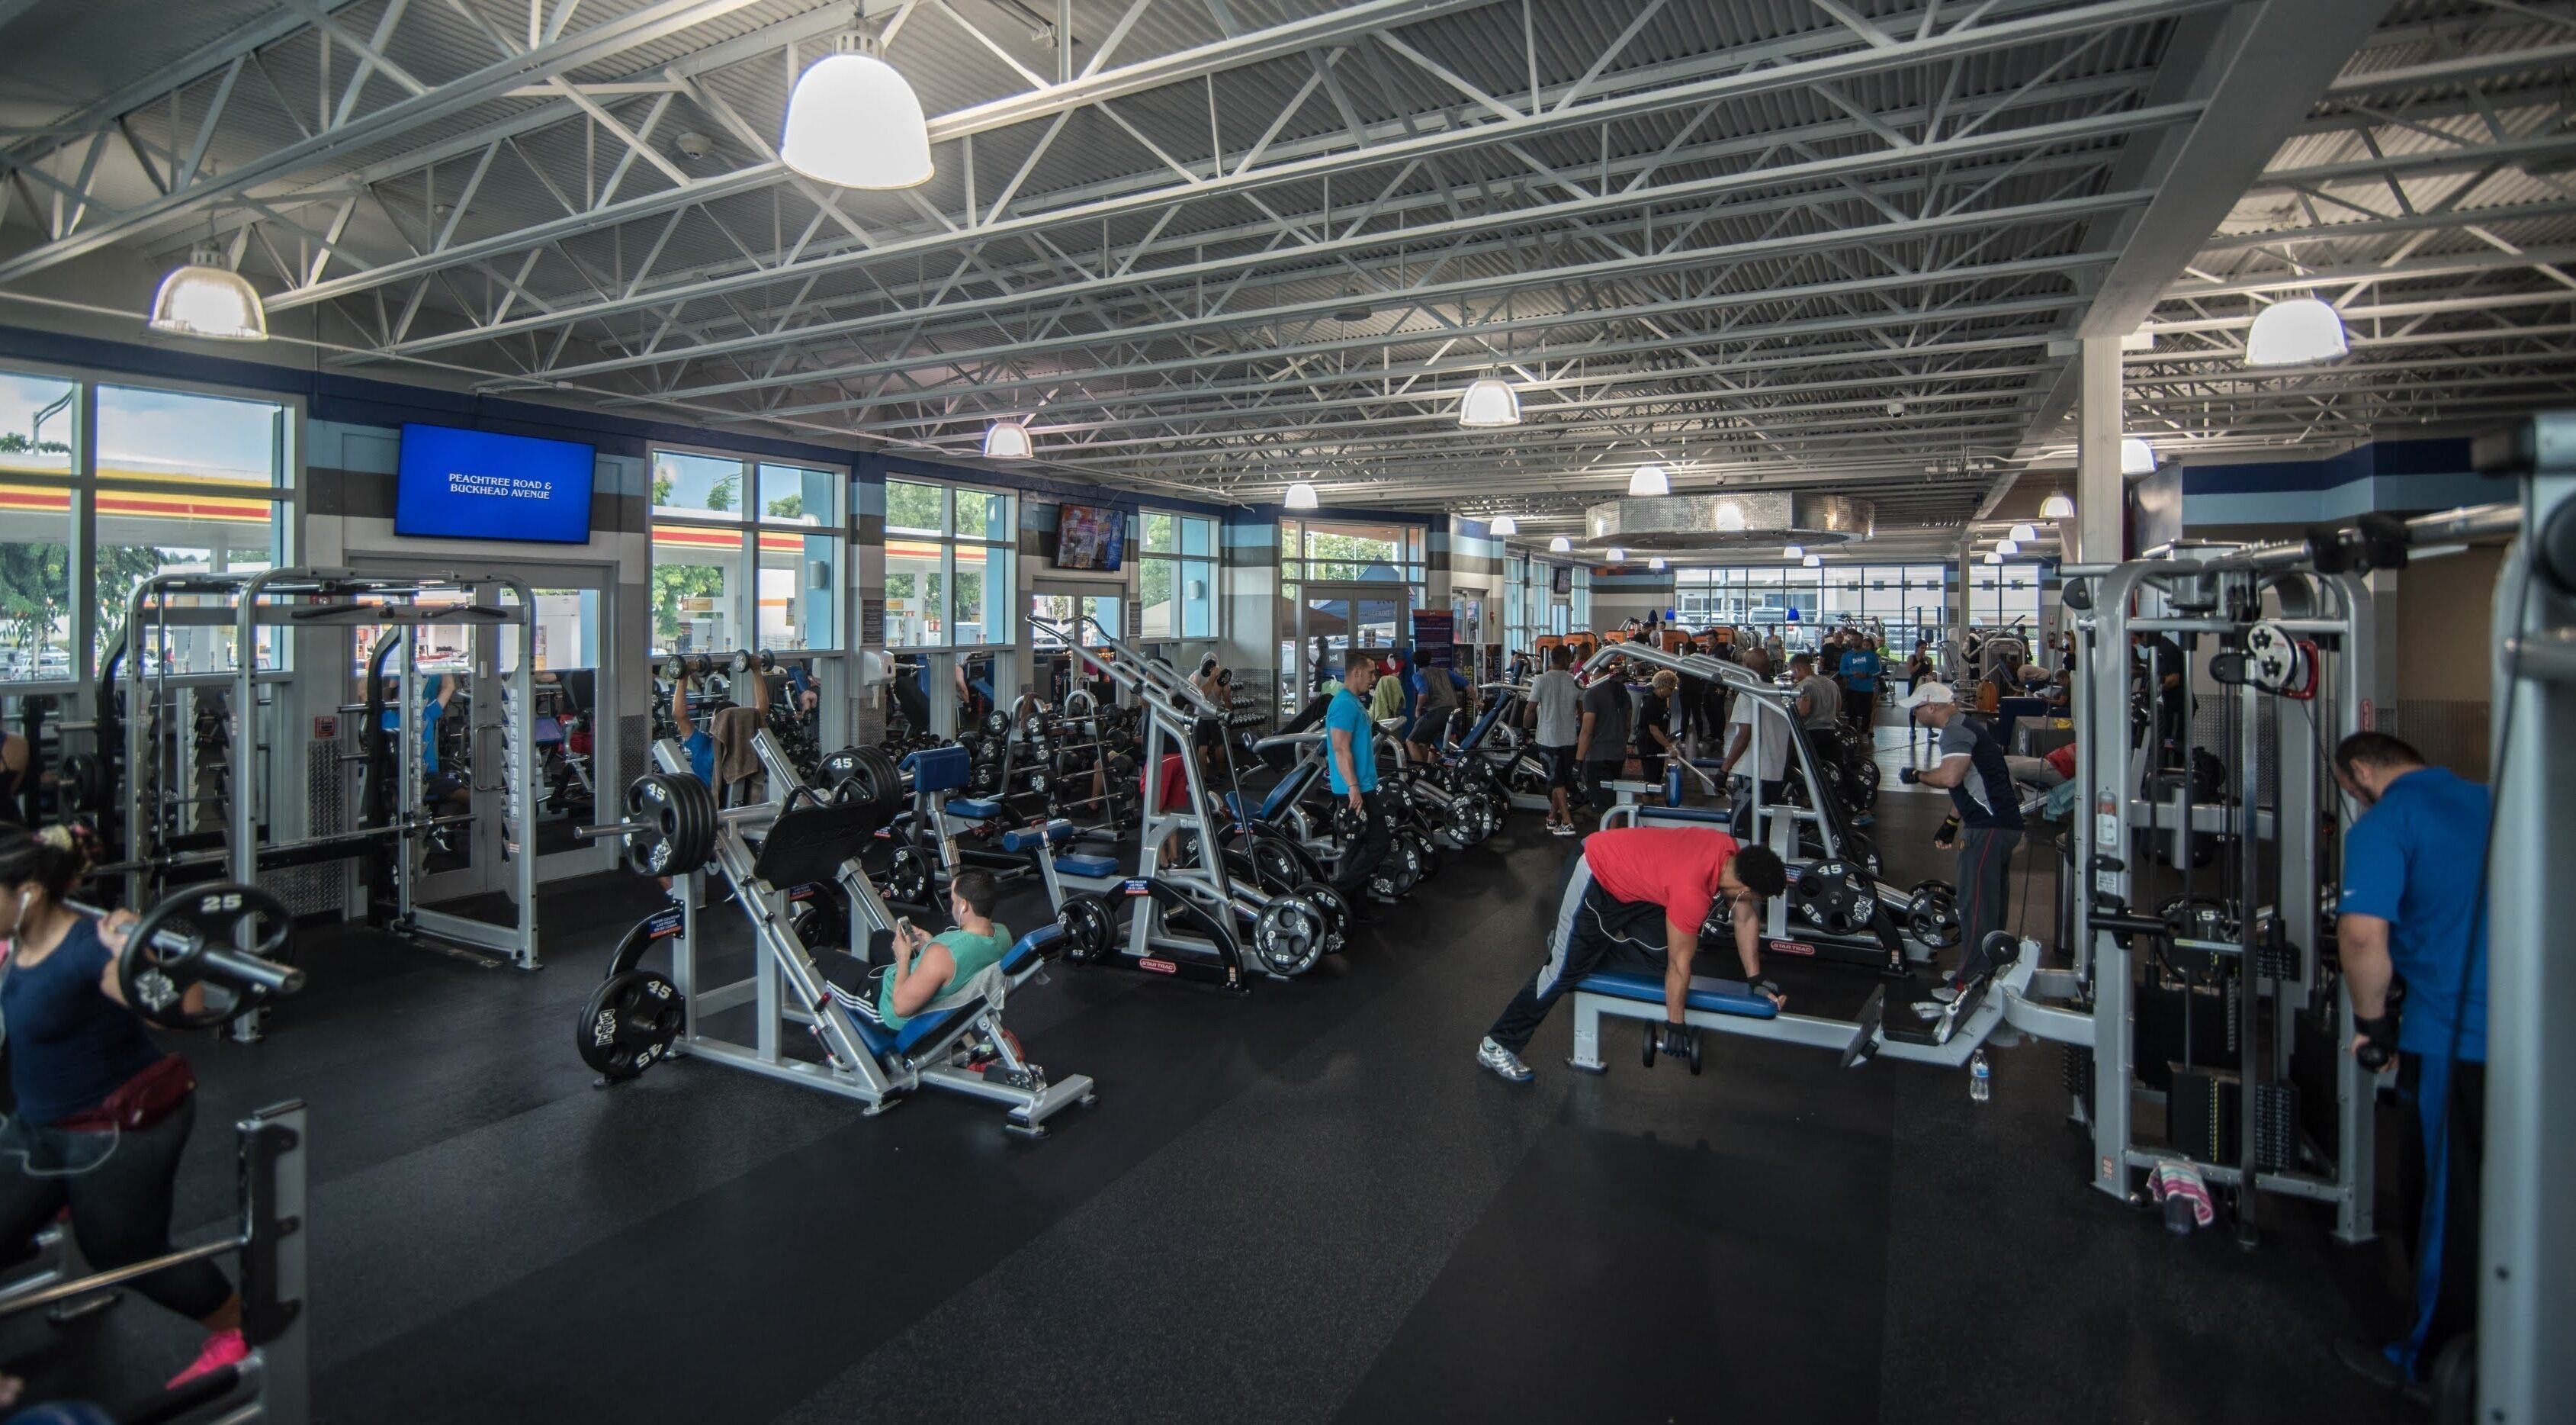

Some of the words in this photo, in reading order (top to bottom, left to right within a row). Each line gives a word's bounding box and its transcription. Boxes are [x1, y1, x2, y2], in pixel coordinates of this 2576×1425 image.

[448, 473, 511, 487] PEACHTREE
[512, 479, 542, 489] ROAD
[544, 481, 552, 490] &
[450, 484, 508, 496] BUCKHEAD
[511, 488, 550, 500] AVENUE
[832, 758, 853, 769] 45
[1484, 763, 1493, 777] 45
[647, 783, 666, 801] 45
[1443, 777, 1452, 792] 45
[1402, 790, 1412, 806] 45
[1338, 808, 1346, 819] 10
[1482, 813, 1490, 830] 45
[1450, 828, 1464, 840] 45
[1419, 836, 1434, 853] 45
[1278, 857, 1289, 873] 35
[1406, 850, 1417, 870] 45
[1817, 864, 1842, 876] 45
[201, 893, 243, 912] 25
[1316, 892, 1336, 907] 45
[1913, 898, 1925, 910] 25
[1264, 914, 1274, 928] 25
[1338, 914, 1344, 927] 25
[1802, 903, 1822, 923] 45
[647, 979, 672, 999] 45
[595, 1008, 616, 1047] CRUNCH
[636, 1043, 663, 1068] 45
